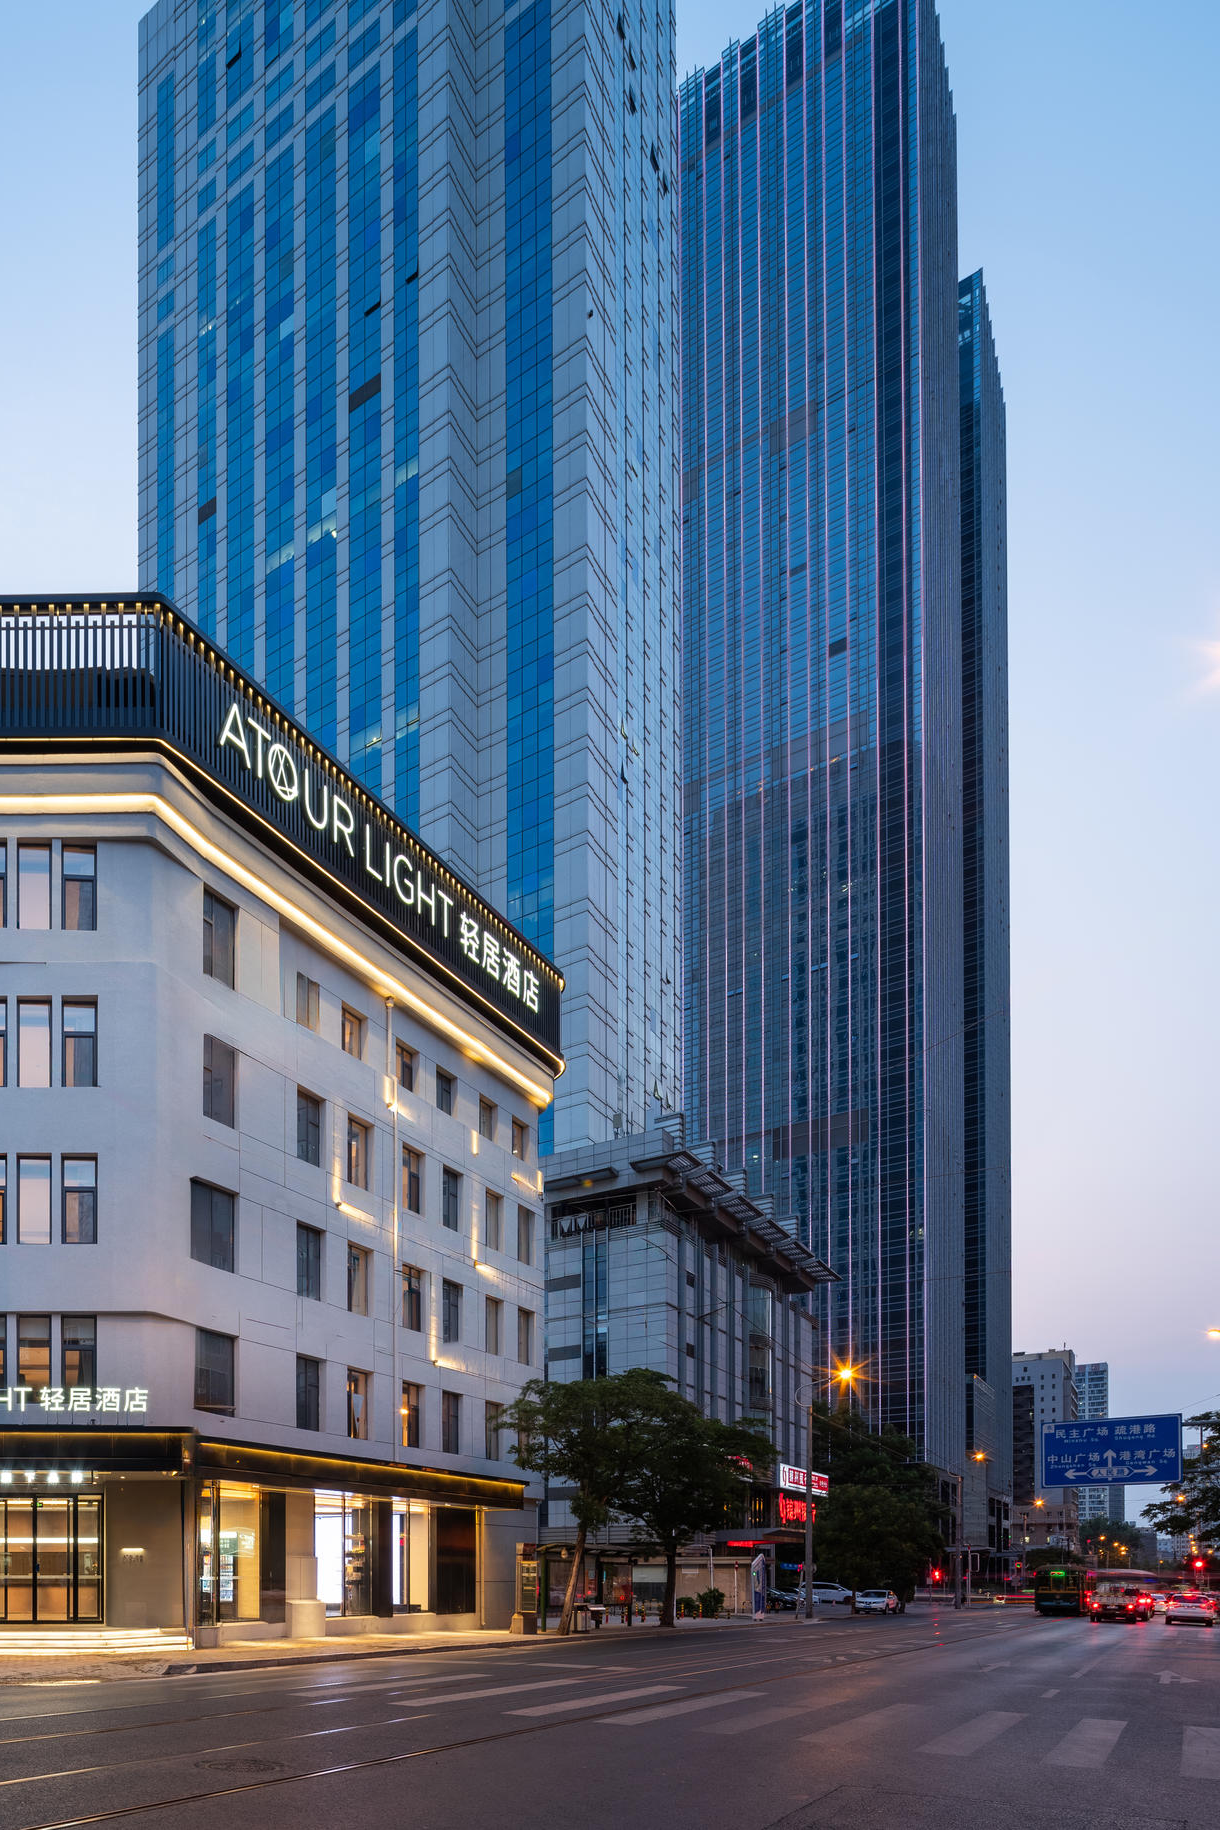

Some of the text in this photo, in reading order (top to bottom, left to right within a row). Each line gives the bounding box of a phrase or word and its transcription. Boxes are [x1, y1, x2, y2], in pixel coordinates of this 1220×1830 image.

[219, 703, 540, 1014] ATOUR LIGHT 轻居酒店
[39, 1386, 149, 1413] 轻居酒店
[1055, 1423, 1156, 1439] 民主广场 疏港路
[1047, 1451, 1100, 1465] 中山广场
[1119, 1447, 1176, 1461] 港湾广场
